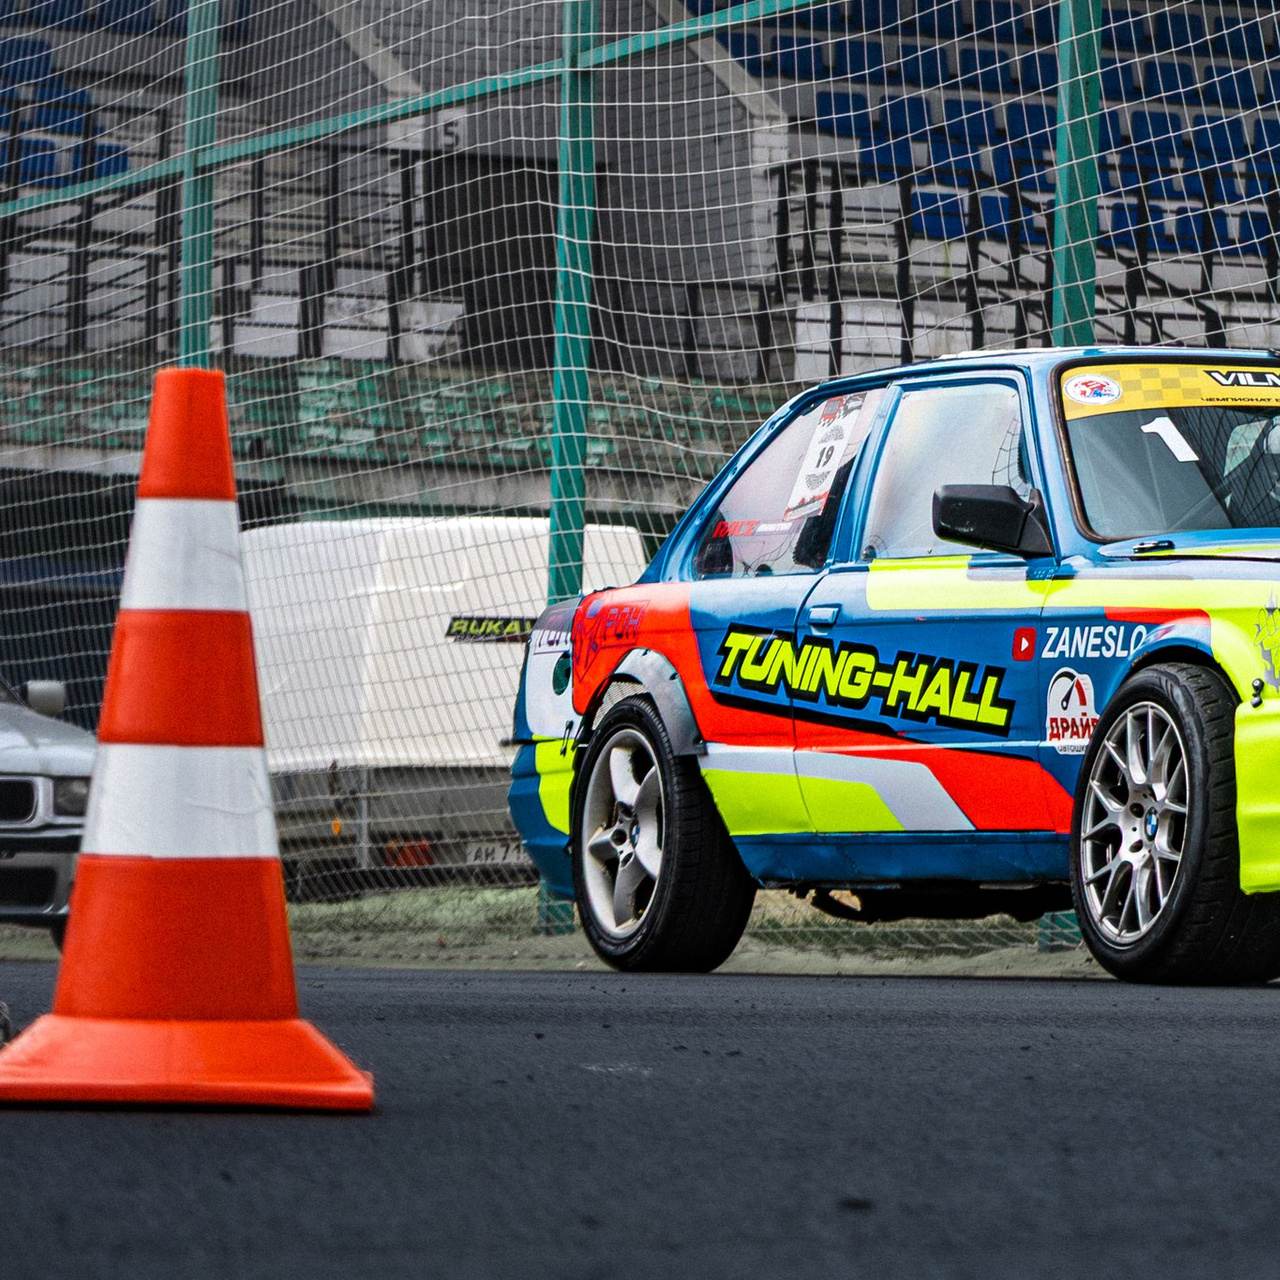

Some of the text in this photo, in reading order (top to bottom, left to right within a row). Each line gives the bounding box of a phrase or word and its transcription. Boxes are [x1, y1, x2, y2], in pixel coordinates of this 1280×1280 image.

[441, 120, 461, 147] 5
[1140, 417, 1199, 462] 1
[815, 445, 835, 468] 19
[713, 520, 759, 537] RACE
[1041, 625, 1147, 659] ZANESLO
[720, 632, 1009, 726] TUNING-HALL
